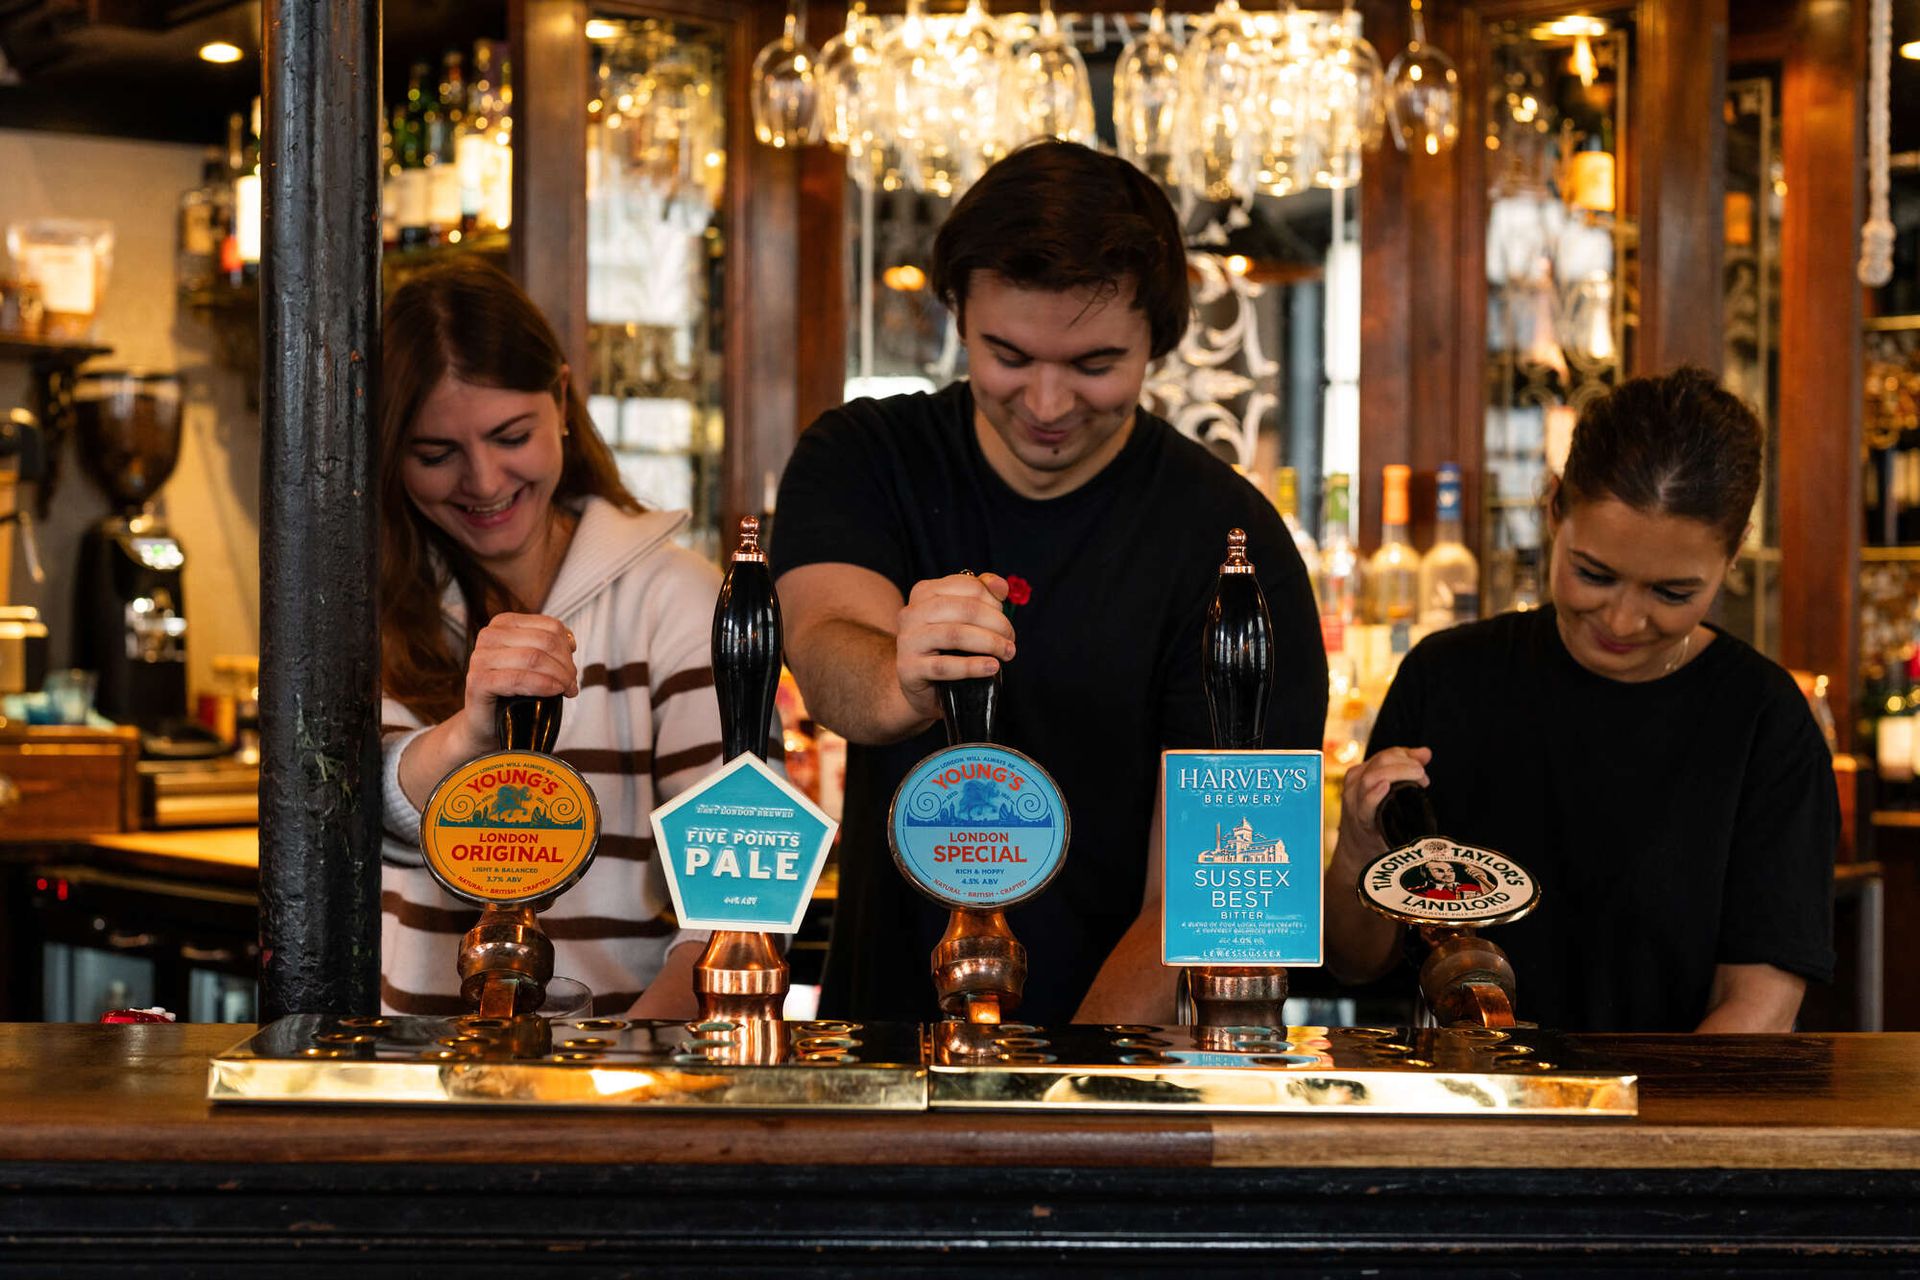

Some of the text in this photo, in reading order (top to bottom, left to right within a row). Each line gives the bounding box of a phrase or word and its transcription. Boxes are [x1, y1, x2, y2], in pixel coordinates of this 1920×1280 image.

[940, 757, 964, 768] LONDON
[983, 757, 1006, 765] ALWAYS
[466, 769, 559, 796] YOUNG'S
[931, 763, 1025, 791] YOUNG'S
[1180, 768, 1307, 789] HARVEY'S
[1204, 795, 1281, 804] BREWERY
[720, 807, 754, 816] LONDON
[757, 808, 793, 818] BREWED
[479, 832, 539, 843] LONDON
[687, 831, 800, 847] FIVE POINTS
[950, 832, 1009, 843] LONDON
[451, 844, 564, 863] ORIGINAL
[933, 845, 1028, 863] SPECIAL
[685, 847, 799, 881] PALE
[1373, 847, 1524, 891] TIMOTHY TAYLOR'S
[458, 876, 483, 891] NATURAL
[522, 877, 551, 892] CRAFTED
[933, 879, 960, 895] NATURAL
[1000, 880, 1027, 895] CRAFTED
[1194, 869, 1290, 887] SUSSEX
[1211, 890, 1273, 908] BEST
[1402, 892, 1511, 912] LANDLORD
